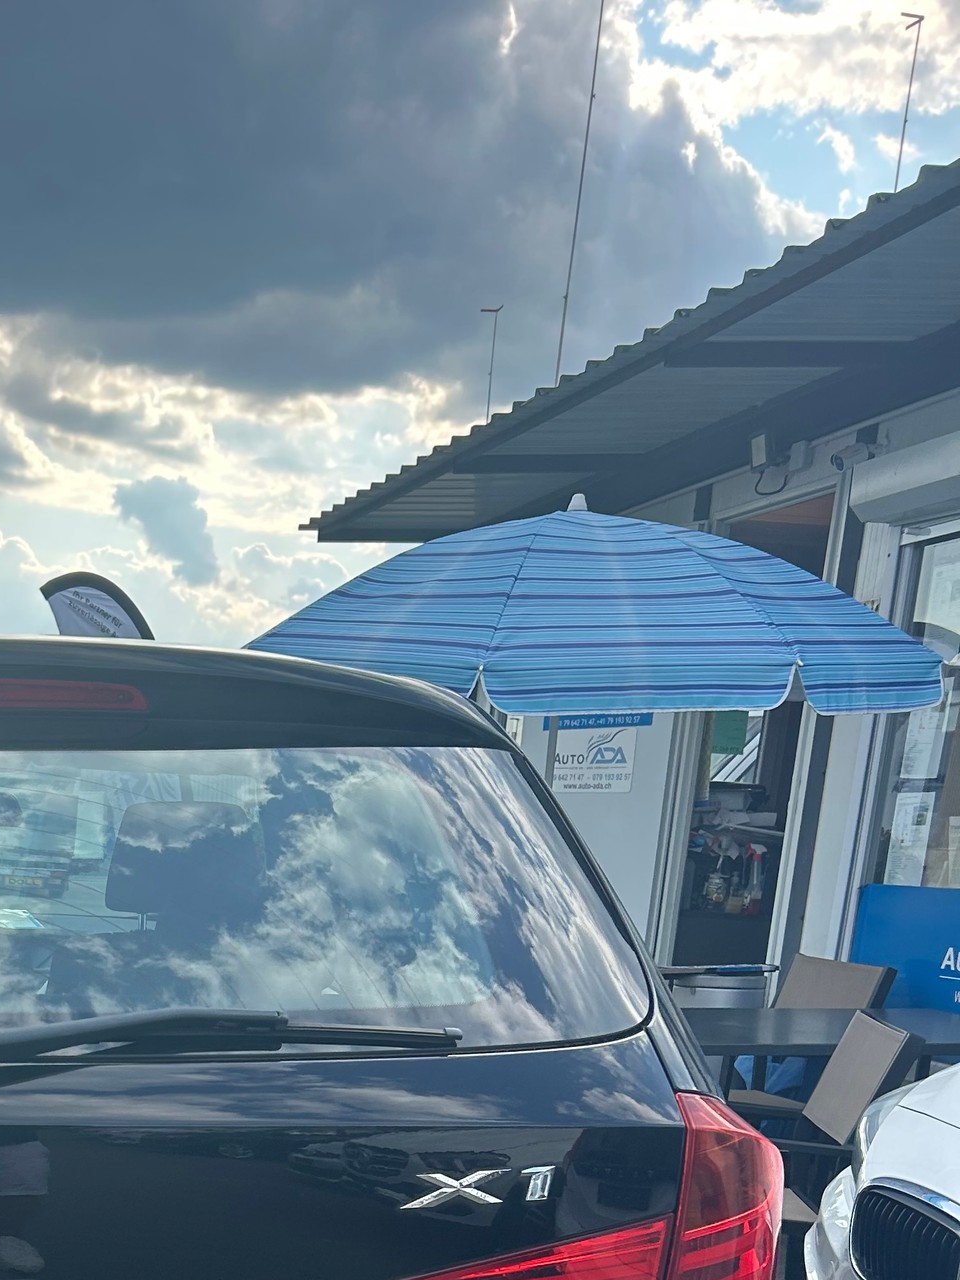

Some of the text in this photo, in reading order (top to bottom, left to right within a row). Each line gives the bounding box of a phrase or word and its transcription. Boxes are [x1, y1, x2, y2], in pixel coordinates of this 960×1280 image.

[111, 616, 123, 629] für
[615, 717, 624, 725] 193
[625, 716, 633, 724] 92
[633, 715, 640, 723] 57
[554, 746, 627, 765] AUTO ADA
